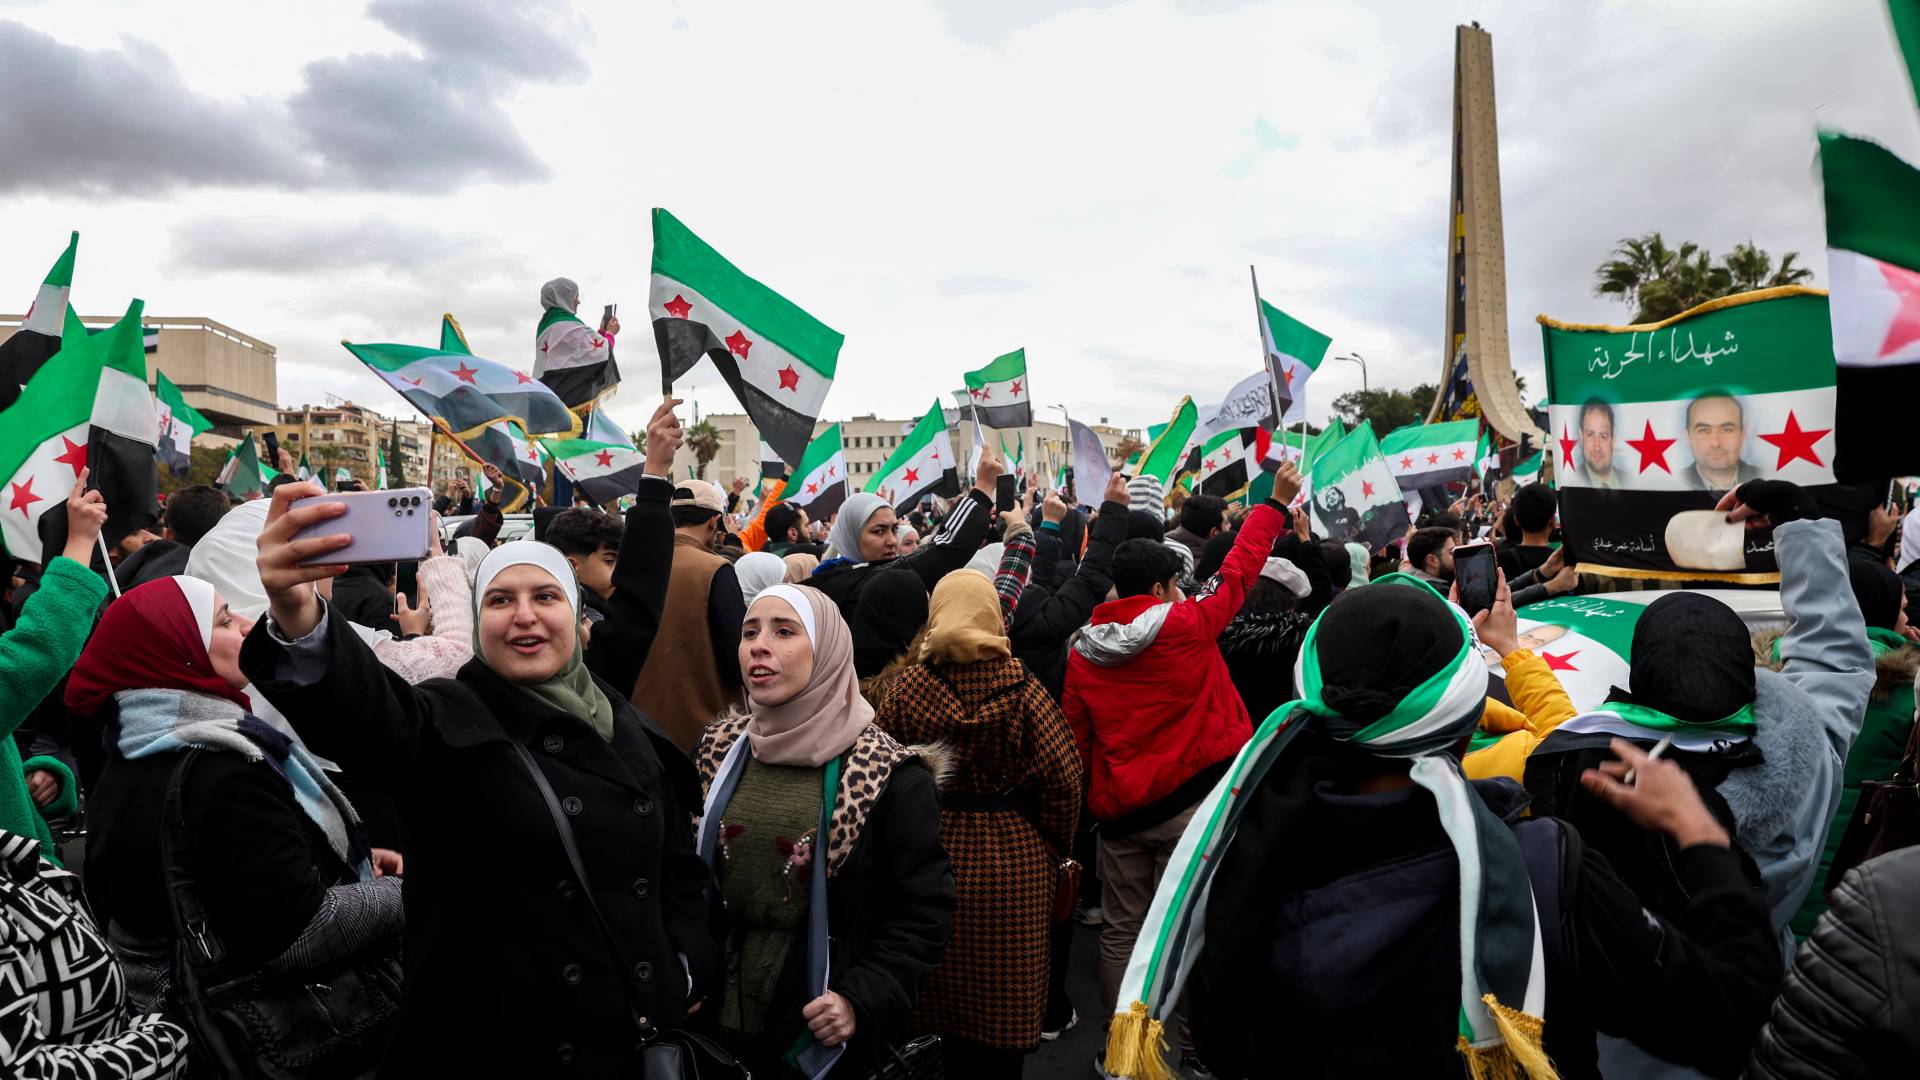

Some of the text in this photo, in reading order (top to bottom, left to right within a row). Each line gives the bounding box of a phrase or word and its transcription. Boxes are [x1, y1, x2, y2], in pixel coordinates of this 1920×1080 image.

[1588, 327, 1739, 379] شهداء الحرية
[1629, 533, 1655, 552] أسامة
